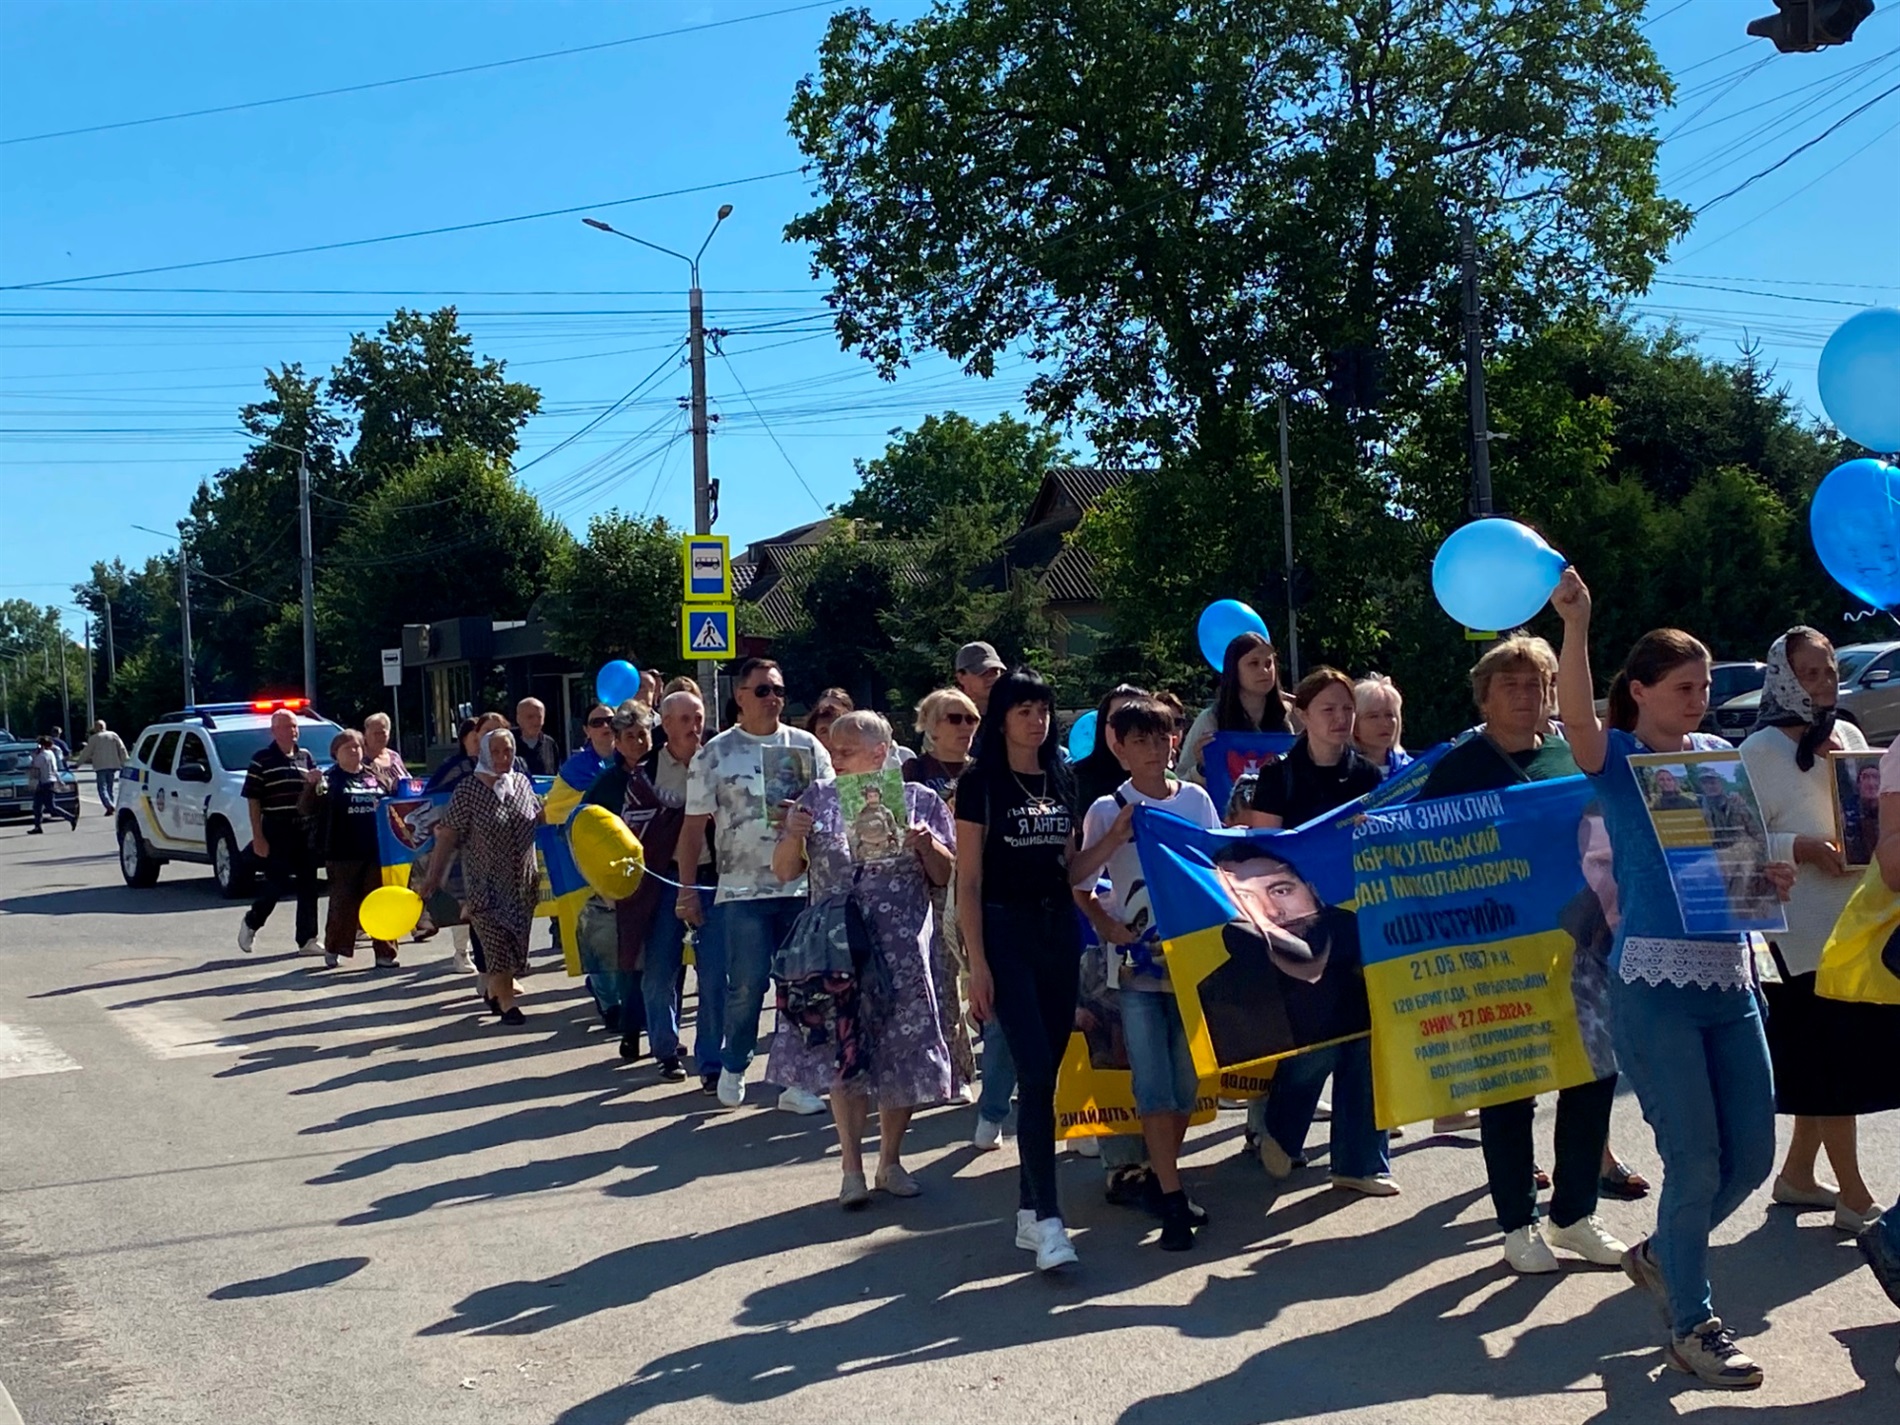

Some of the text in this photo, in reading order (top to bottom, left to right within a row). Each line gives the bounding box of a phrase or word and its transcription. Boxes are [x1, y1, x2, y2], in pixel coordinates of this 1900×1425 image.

[1018, 818, 1030, 835] Я
[1416, 791, 1505, 830] ЗНИКЛИЙ
[1383, 897, 1516, 947] «ШУСТРИЙ»
[1419, 1013, 1457, 1038] ЗНИК
